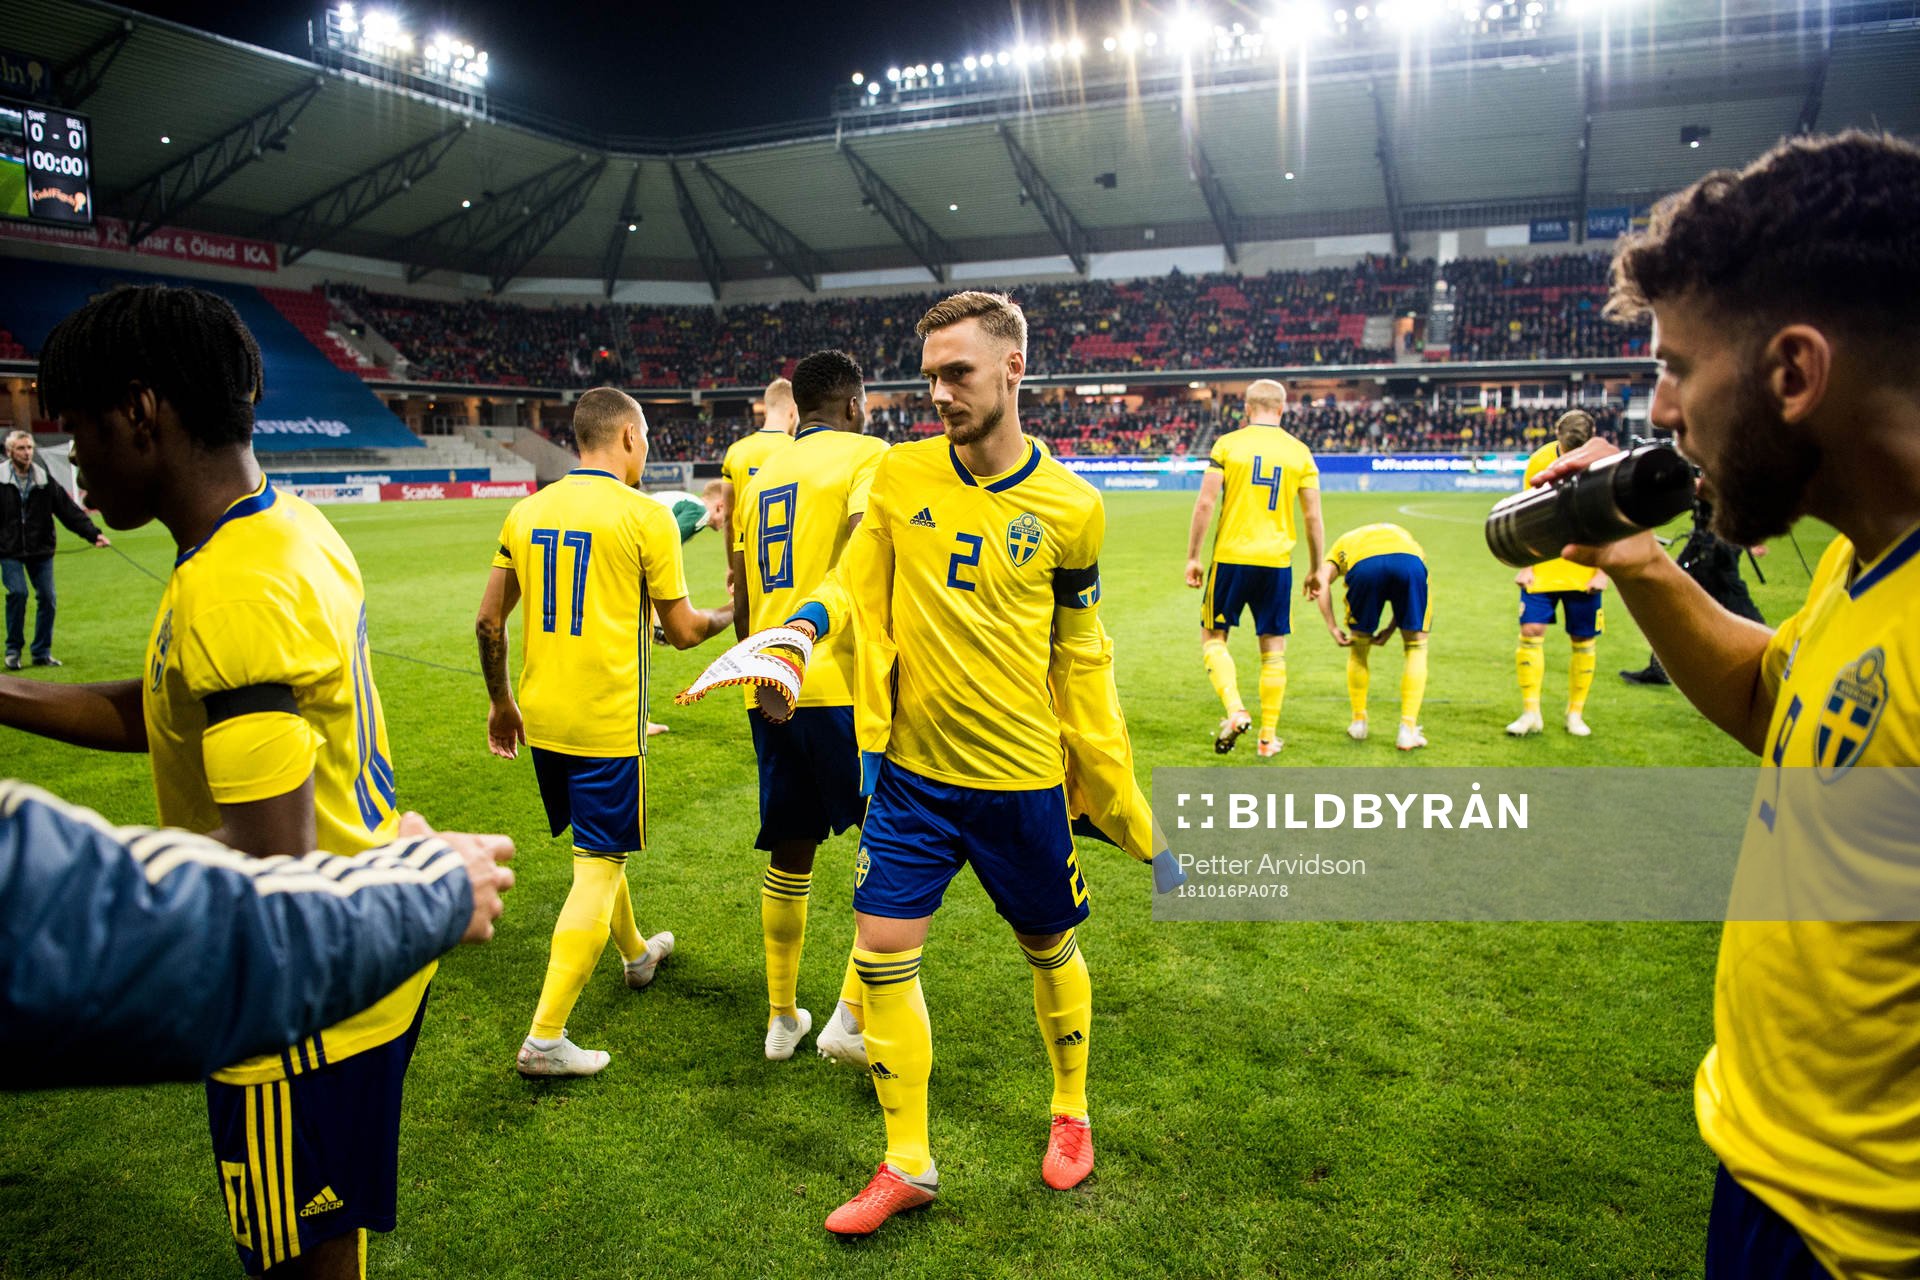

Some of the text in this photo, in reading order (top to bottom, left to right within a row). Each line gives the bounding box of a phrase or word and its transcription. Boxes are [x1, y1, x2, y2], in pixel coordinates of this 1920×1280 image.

[27, 109, 83, 131] SWE BEL
[31, 122, 43, 142] 0
[69, 130, 81, 150] 0
[33, 150, 83, 177] 00:00
[1589, 215, 1626, 231] UEFA
[174, 236, 187, 254] &
[190, 236, 235, 261] Öland
[244, 245, 271, 265] ICA
[307, 487, 363, 498] INTERSPORT
[401, 485, 446, 499] Scandic
[1252, 455, 1282, 511] 4
[910, 518, 936, 528] adidas
[758, 482, 798, 594] 8
[947, 532, 984, 592] 2
[531, 528, 592, 636] 11
[1066, 850, 1092, 908] 2
[300, 1200, 344, 1218] adidas
